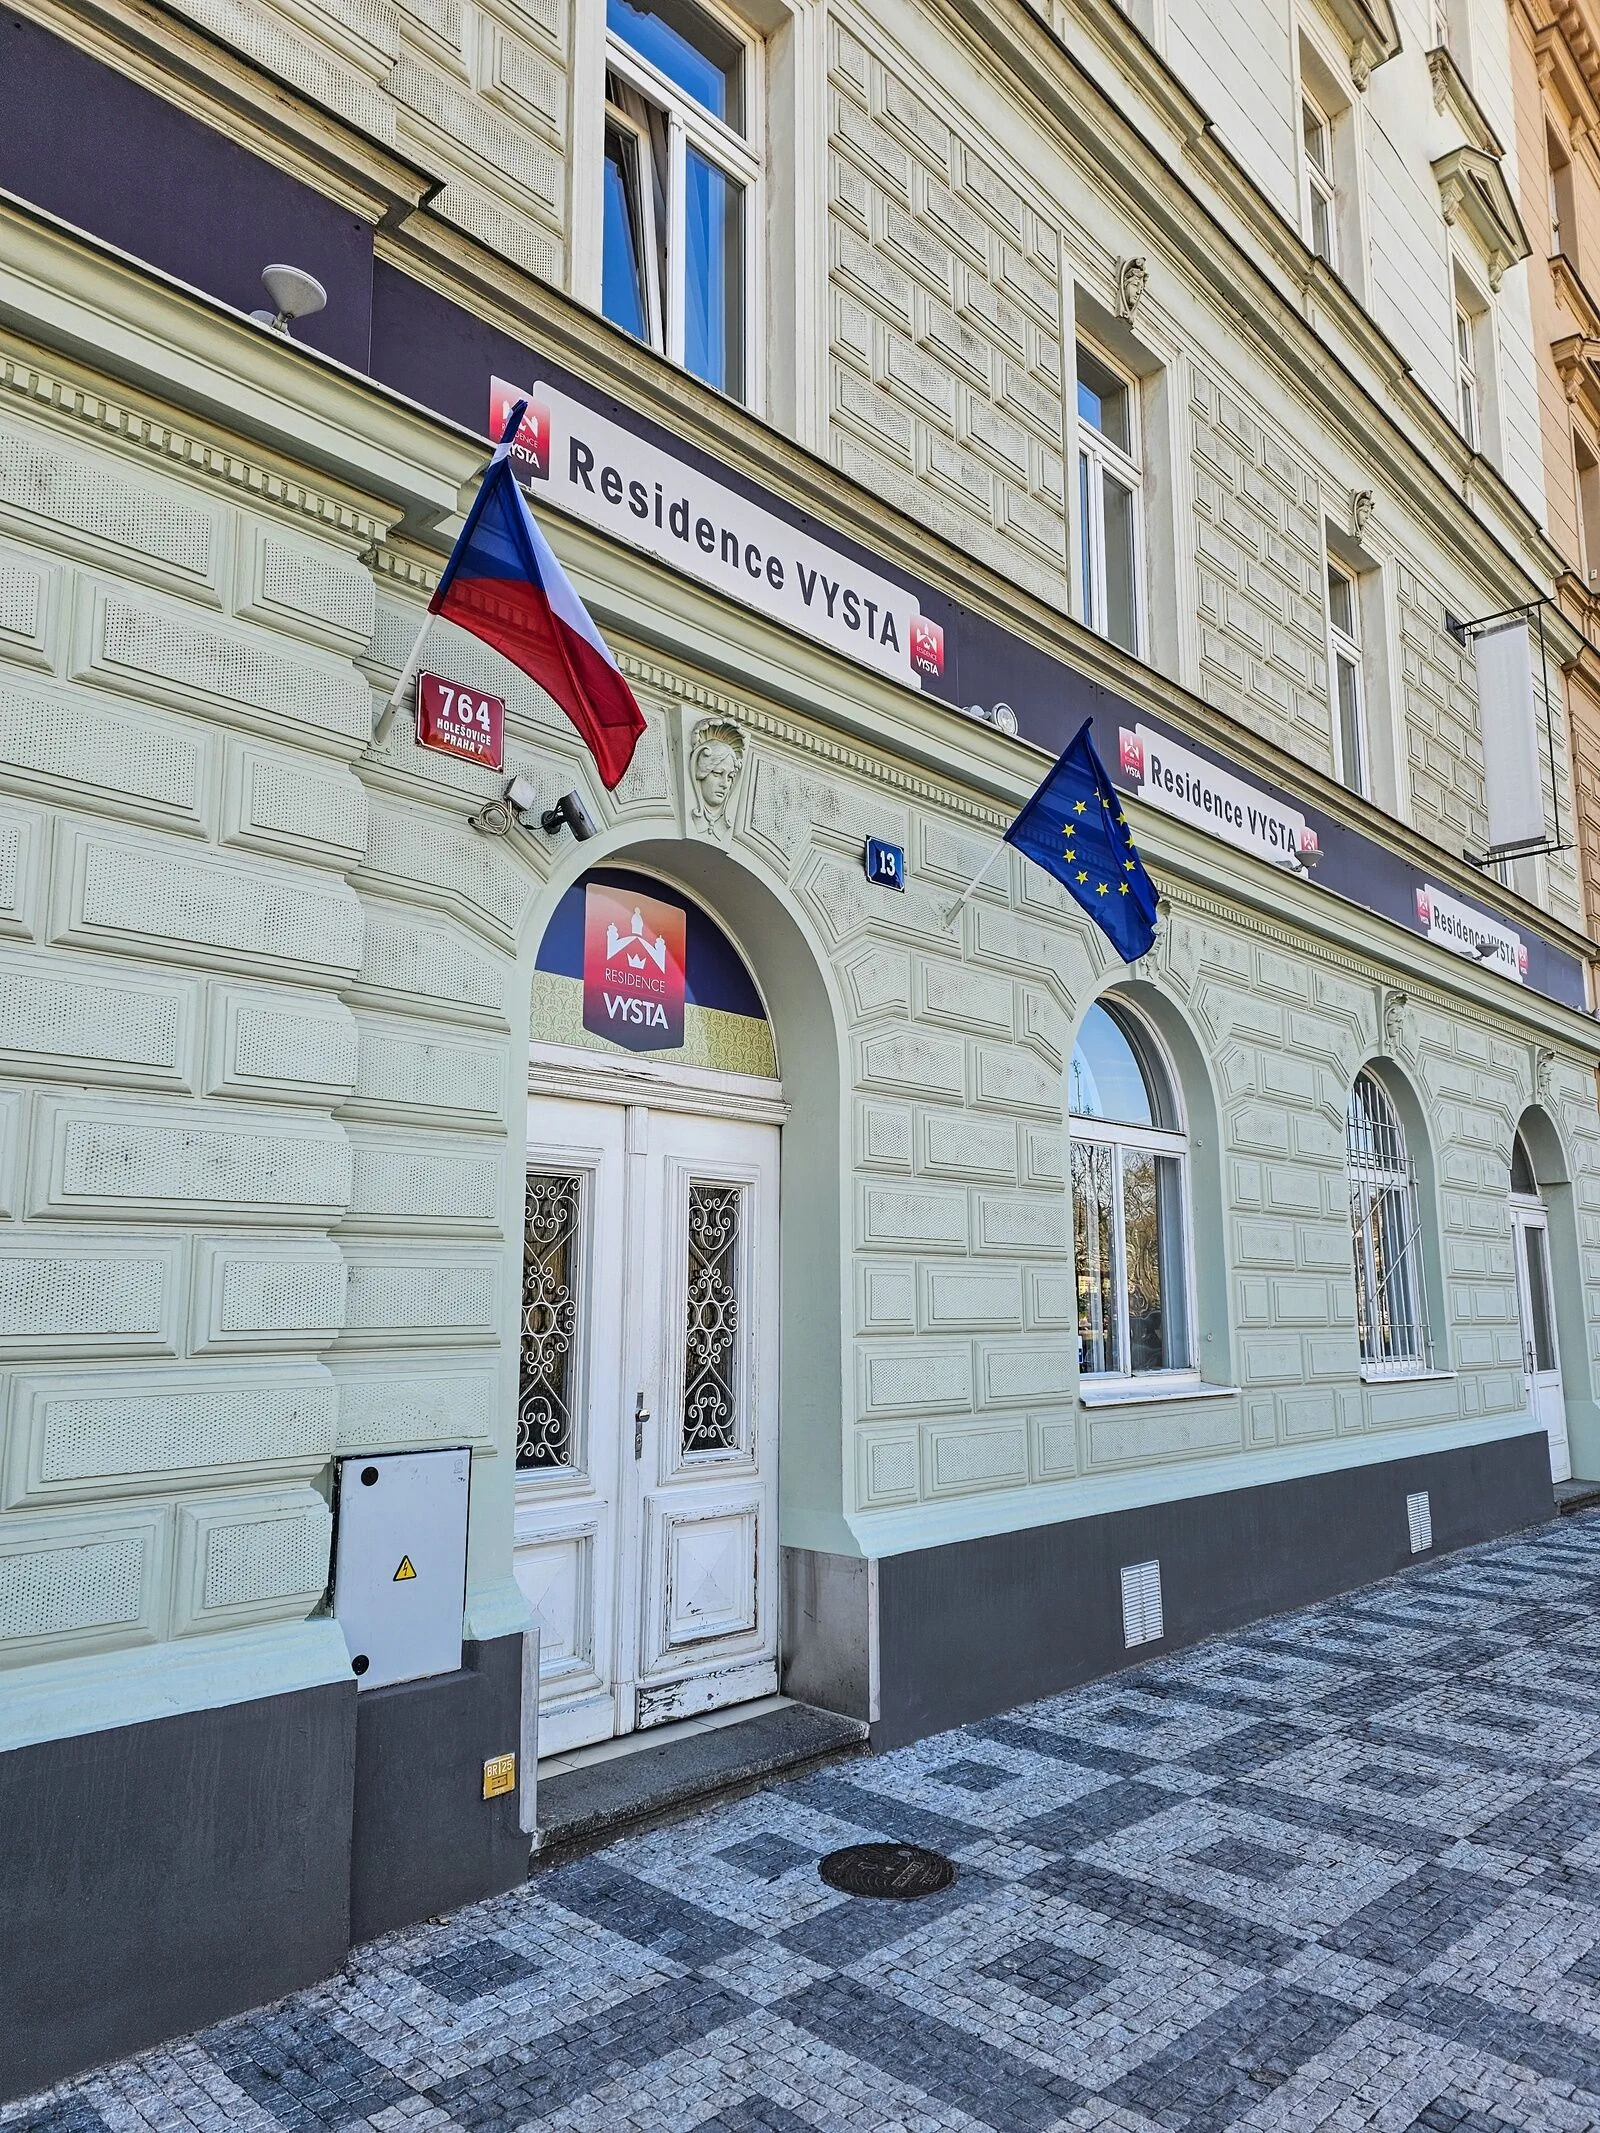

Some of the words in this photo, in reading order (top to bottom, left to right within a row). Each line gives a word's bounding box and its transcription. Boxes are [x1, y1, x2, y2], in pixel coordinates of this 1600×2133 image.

[502, 423, 538, 449] RDENCE
[502, 440, 540, 469] YSTA
[569, 436, 785, 590] Residence
[796, 561, 900, 653] VYSTA
[915, 655, 939, 677] VYSTA
[438, 684, 491, 732] 764
[436, 717, 492, 746] HOLEŠOVICE
[443, 733, 475, 752] PRAHA
[477, 744, 484, 755] 7
[1151, 754, 1242, 828] Residence
[1247, 805, 1296, 853] VYSTA
[880, 850, 896, 876] 13
[604, 967, 666, 994] RESIDENCE
[602, 992, 669, 1031] VYSTA
[487, 1764, 498, 1778] BR
[501, 1759, 513, 1773] 25
